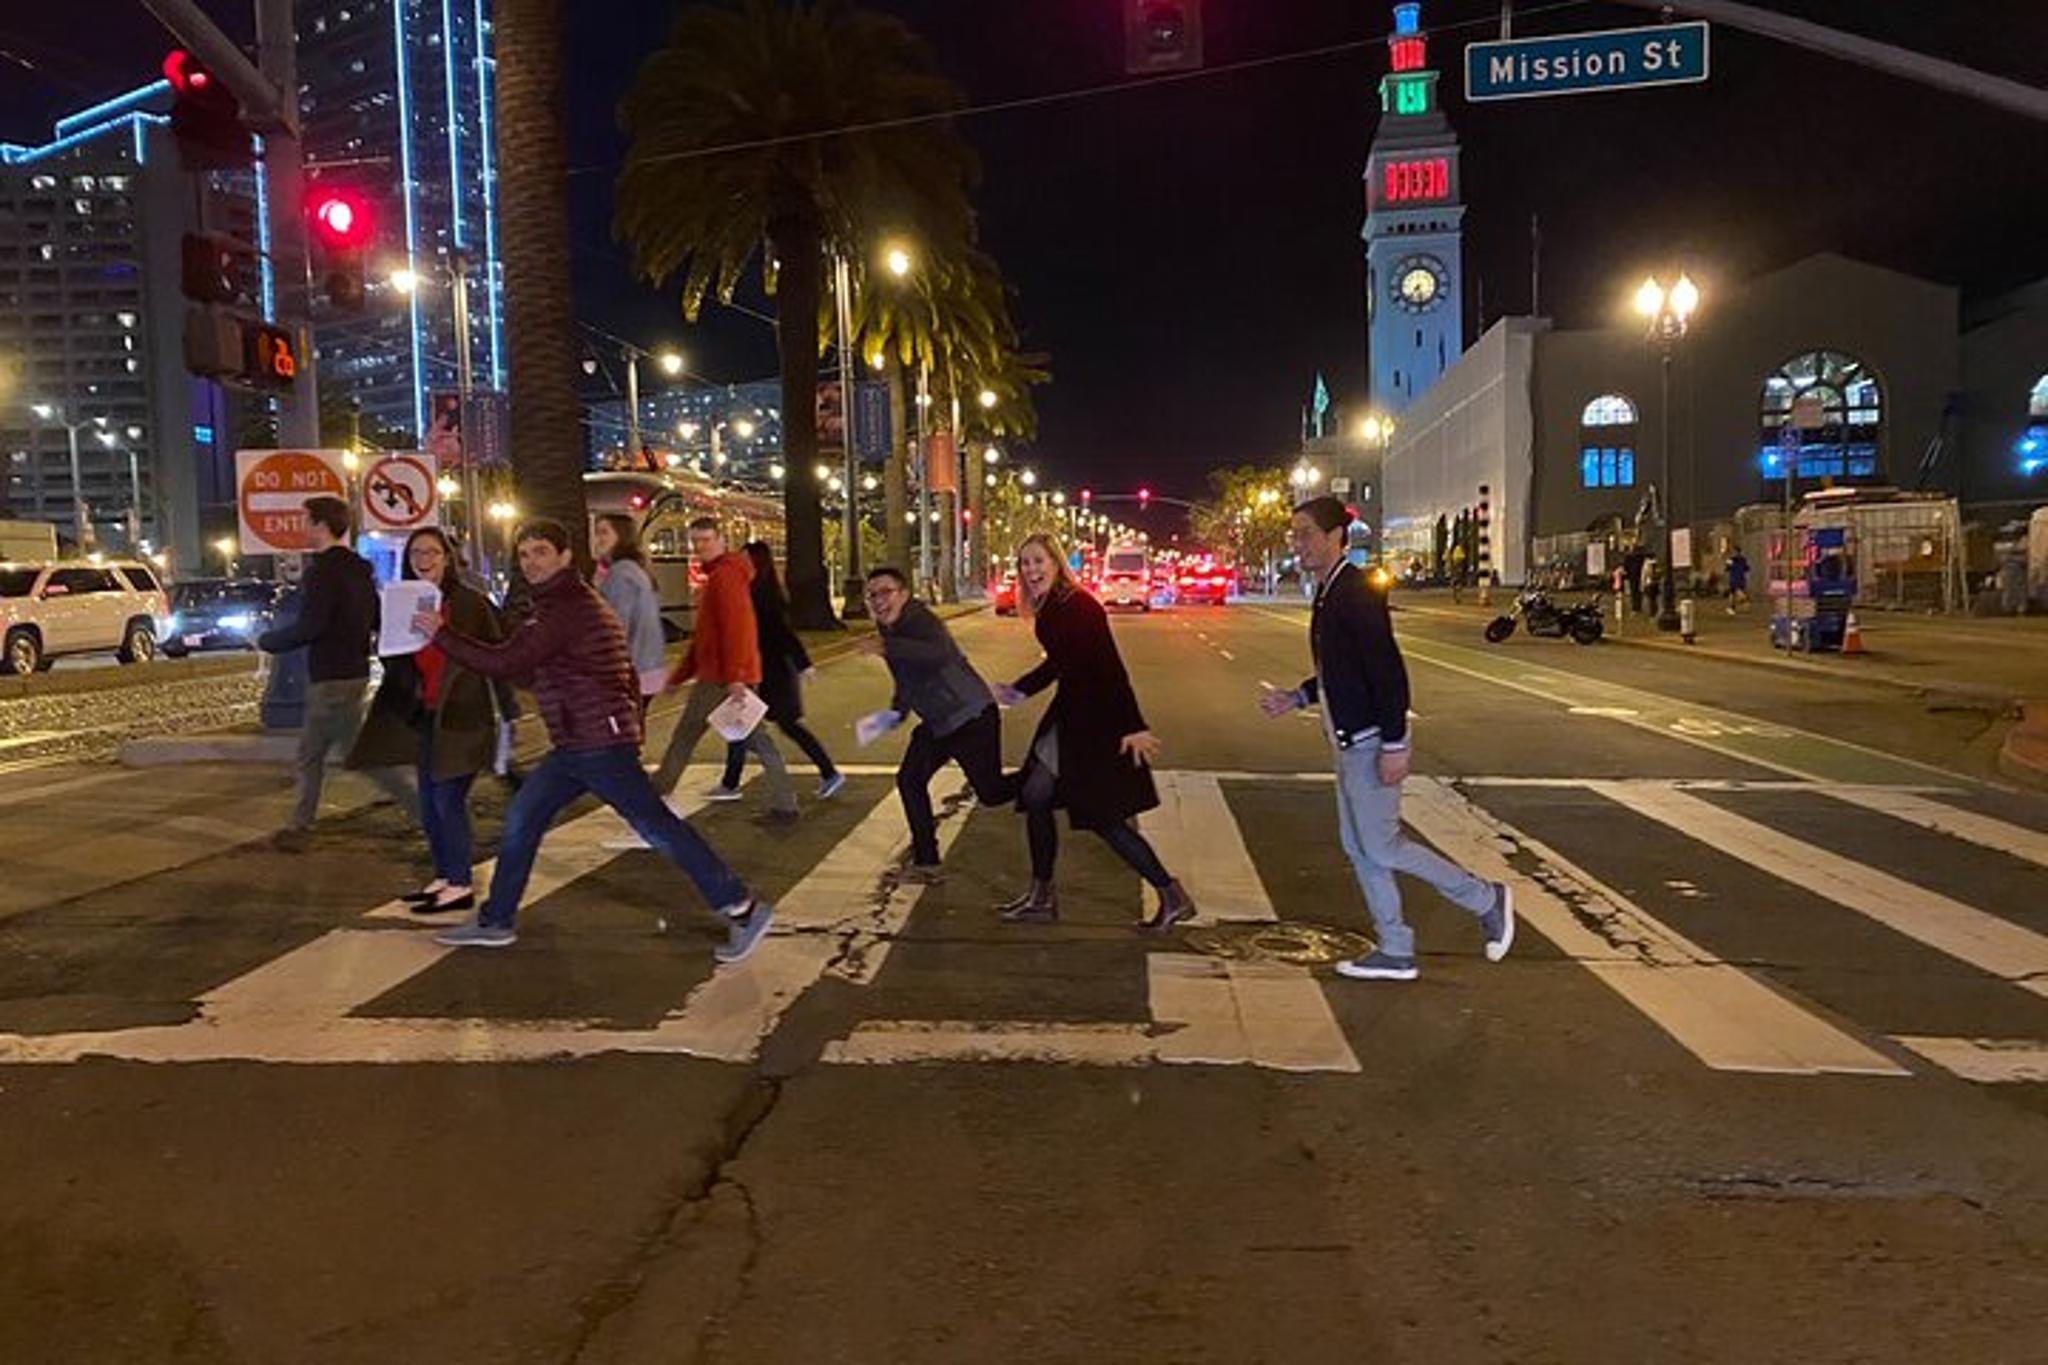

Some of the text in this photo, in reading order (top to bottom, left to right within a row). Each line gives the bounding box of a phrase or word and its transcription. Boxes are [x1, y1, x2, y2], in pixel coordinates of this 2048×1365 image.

[1489, 39, 1682, 85] Mission St
[255, 471, 329, 488] DO NOT
[264, 515, 306, 533] ENT
